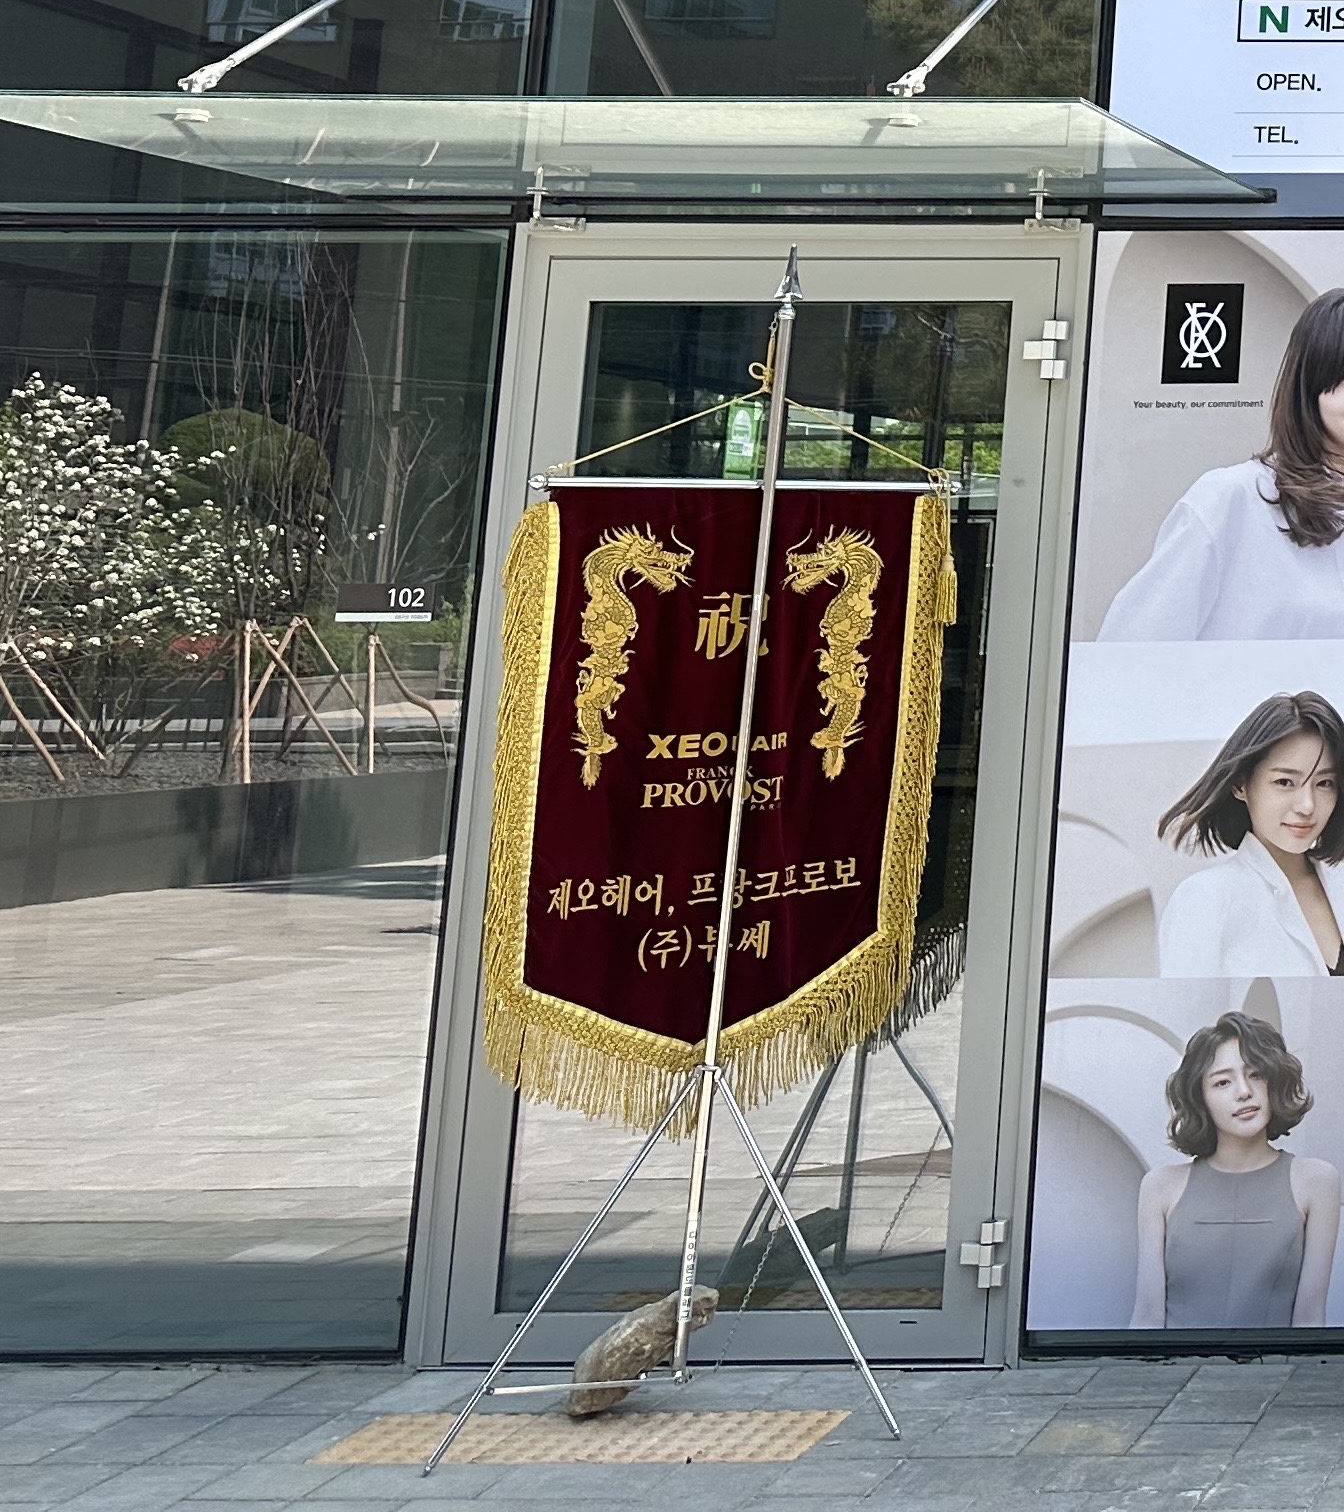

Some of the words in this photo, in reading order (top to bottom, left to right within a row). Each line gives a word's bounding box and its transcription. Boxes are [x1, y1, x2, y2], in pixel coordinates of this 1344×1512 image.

[1258, 6, 1289, 34] N
[1256, 73, 1322, 92] OPEN.
[1254, 125, 1299, 145] TEL.
[1133, 400, 1154, 409] Your
[1190, 401, 1207, 409] our
[1207, 400, 1264, 409] commitment
[387, 587, 426, 608] 102
[547, 874, 675, 920] 제오헤어,
